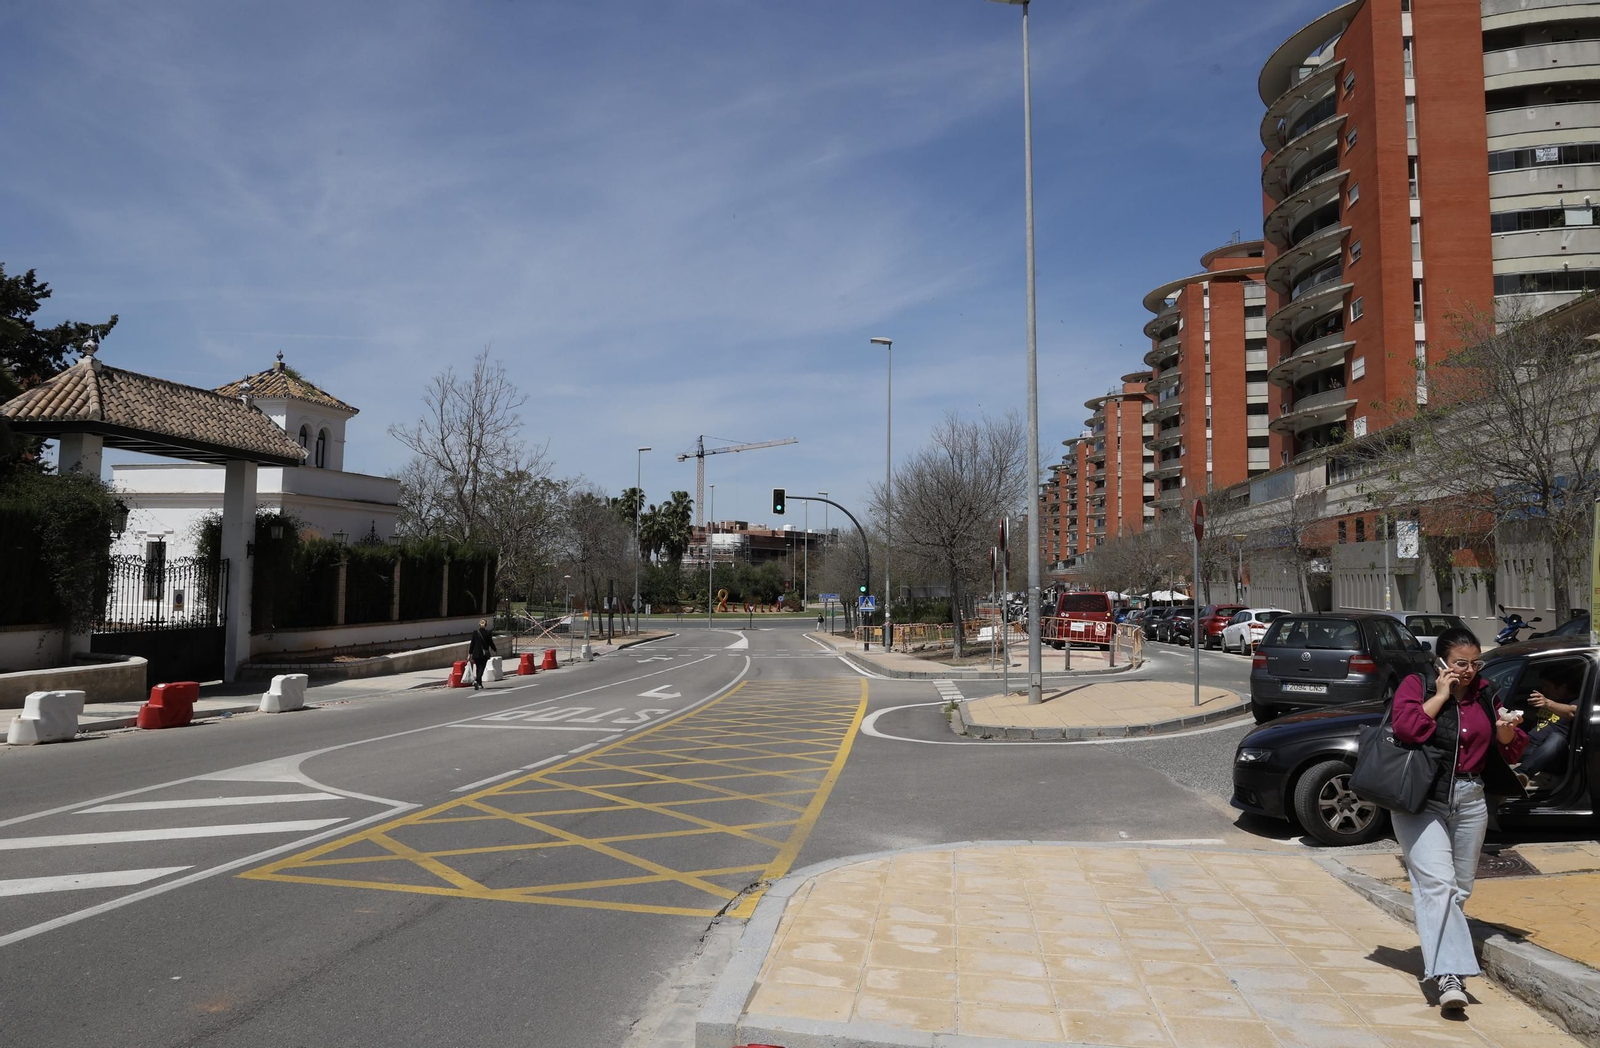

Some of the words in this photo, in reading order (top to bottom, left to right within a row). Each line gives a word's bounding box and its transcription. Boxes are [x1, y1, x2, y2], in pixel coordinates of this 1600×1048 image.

[1289, 683, 1307, 691] 2094
[1308, 684, 1323, 692] CNS
[481, 706, 672, 724] STOP
